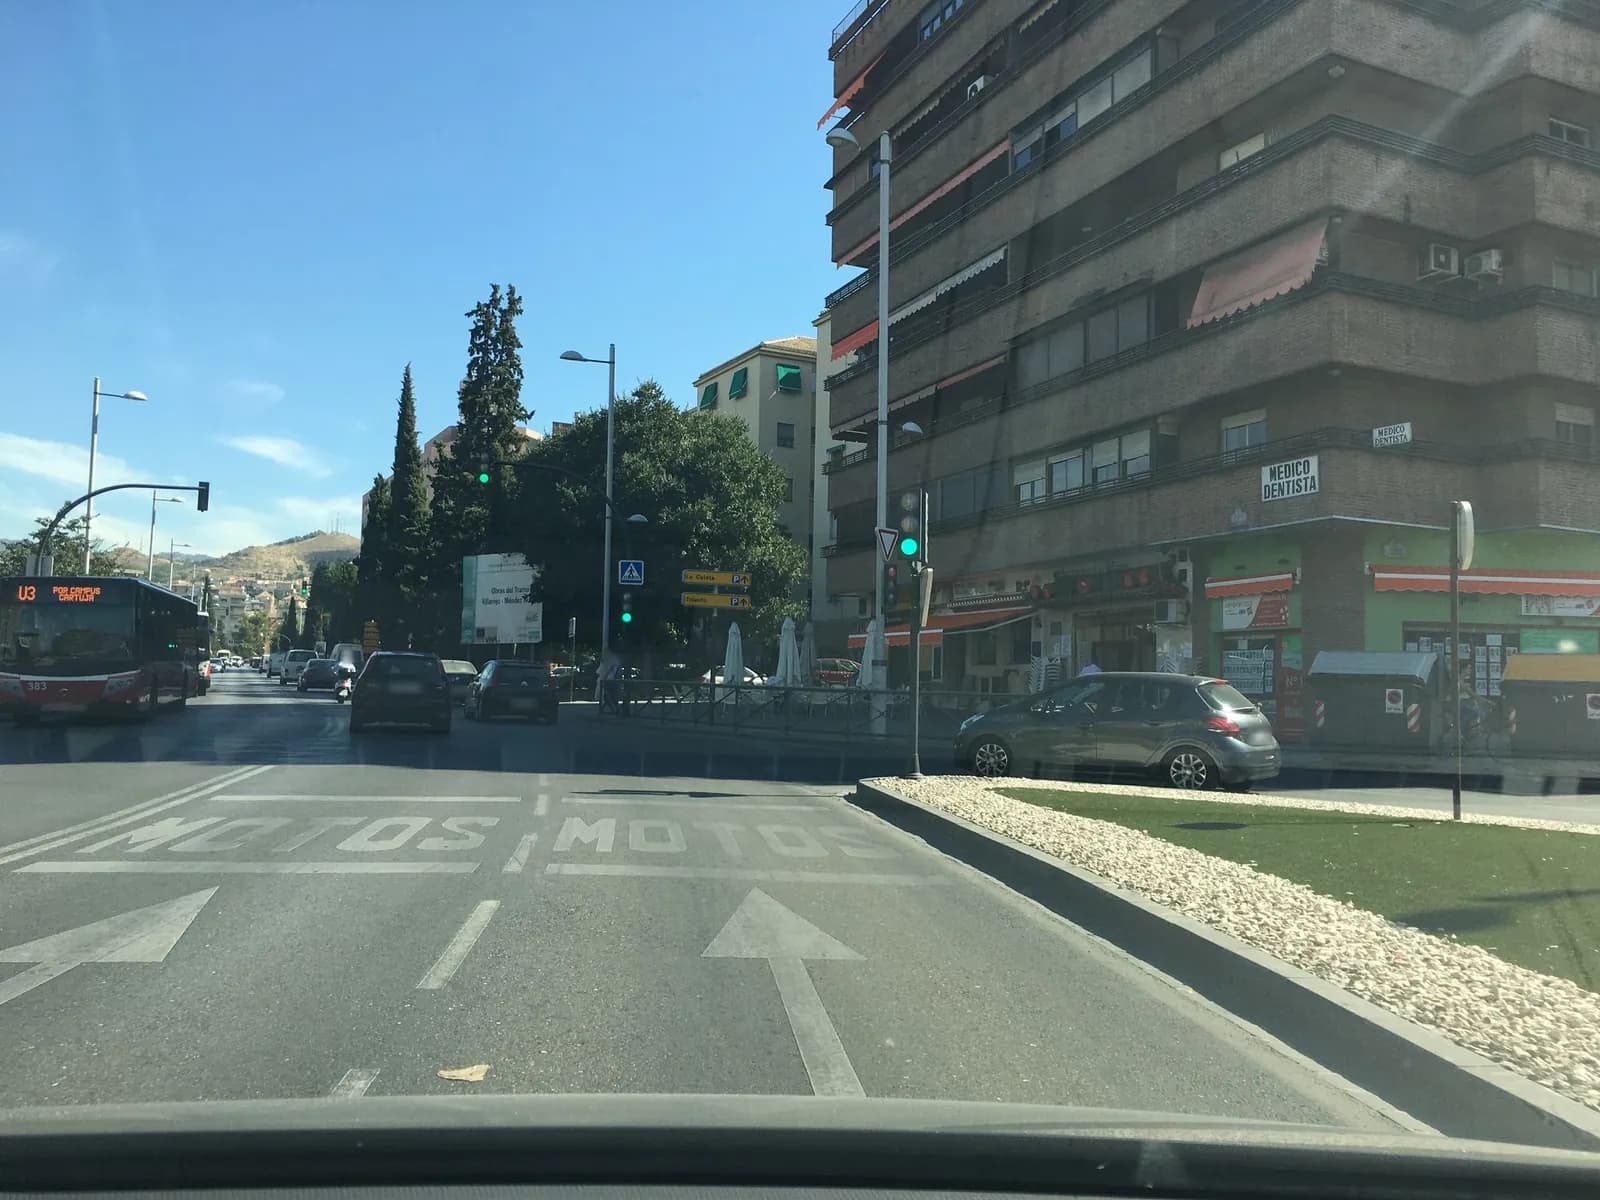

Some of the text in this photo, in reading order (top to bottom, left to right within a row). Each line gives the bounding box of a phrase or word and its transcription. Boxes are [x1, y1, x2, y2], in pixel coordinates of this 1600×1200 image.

[1374, 433, 1408, 447] DENTISTA
[1377, 426, 1405, 438] MEDICO
[1269, 459, 1311, 482] MEDICO
[1263, 475, 1317, 500] DENTISTA
[18, 585, 36, 601] U3
[58, 594, 95, 602] CARTUJA
[70, 586, 101, 595] CAMPUS
[74, 816, 500, 854] MOTOS
[553, 815, 896, 859] MOTOS
